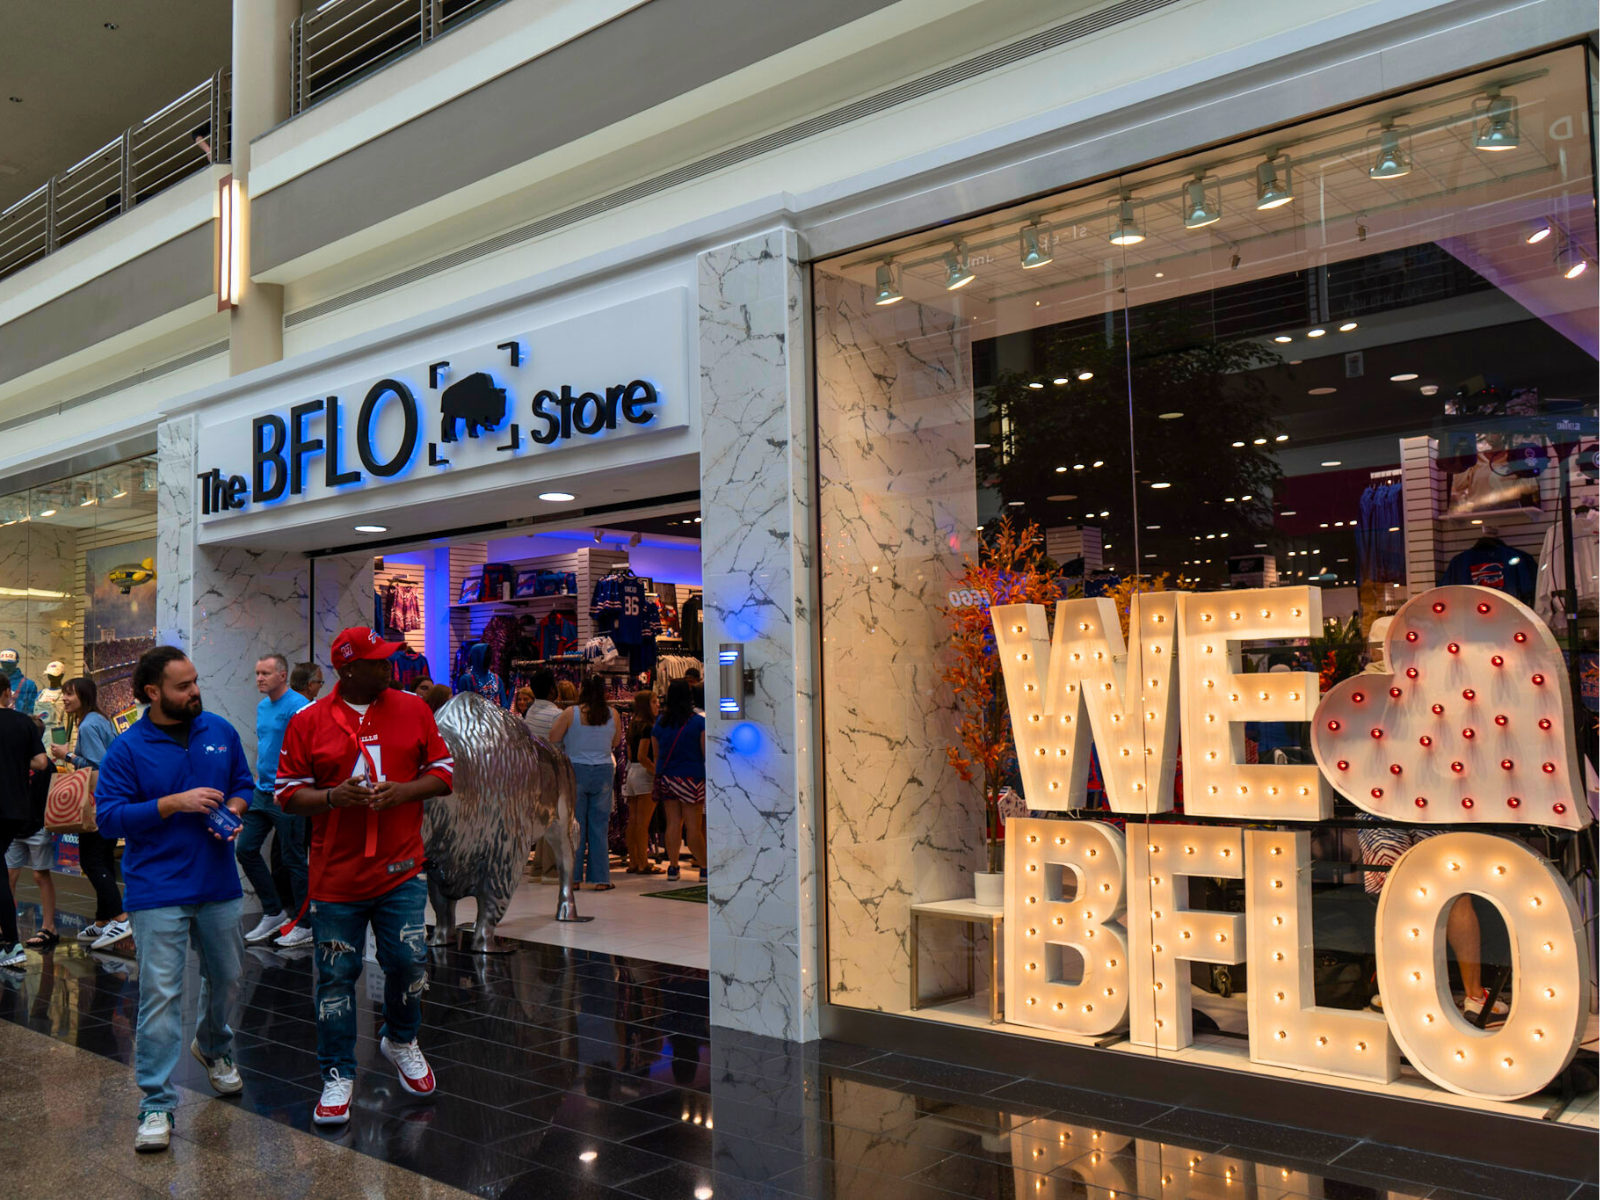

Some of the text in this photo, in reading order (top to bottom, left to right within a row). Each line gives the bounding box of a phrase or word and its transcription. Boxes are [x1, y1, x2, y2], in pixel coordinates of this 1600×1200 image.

[197, 379, 659, 515] The BFLO Store
[340, 642, 354, 658] 17
[990, 585, 1334, 821] WE
[360, 733, 379, 743] ILLS
[1004, 817, 1589, 1101] BFLO
